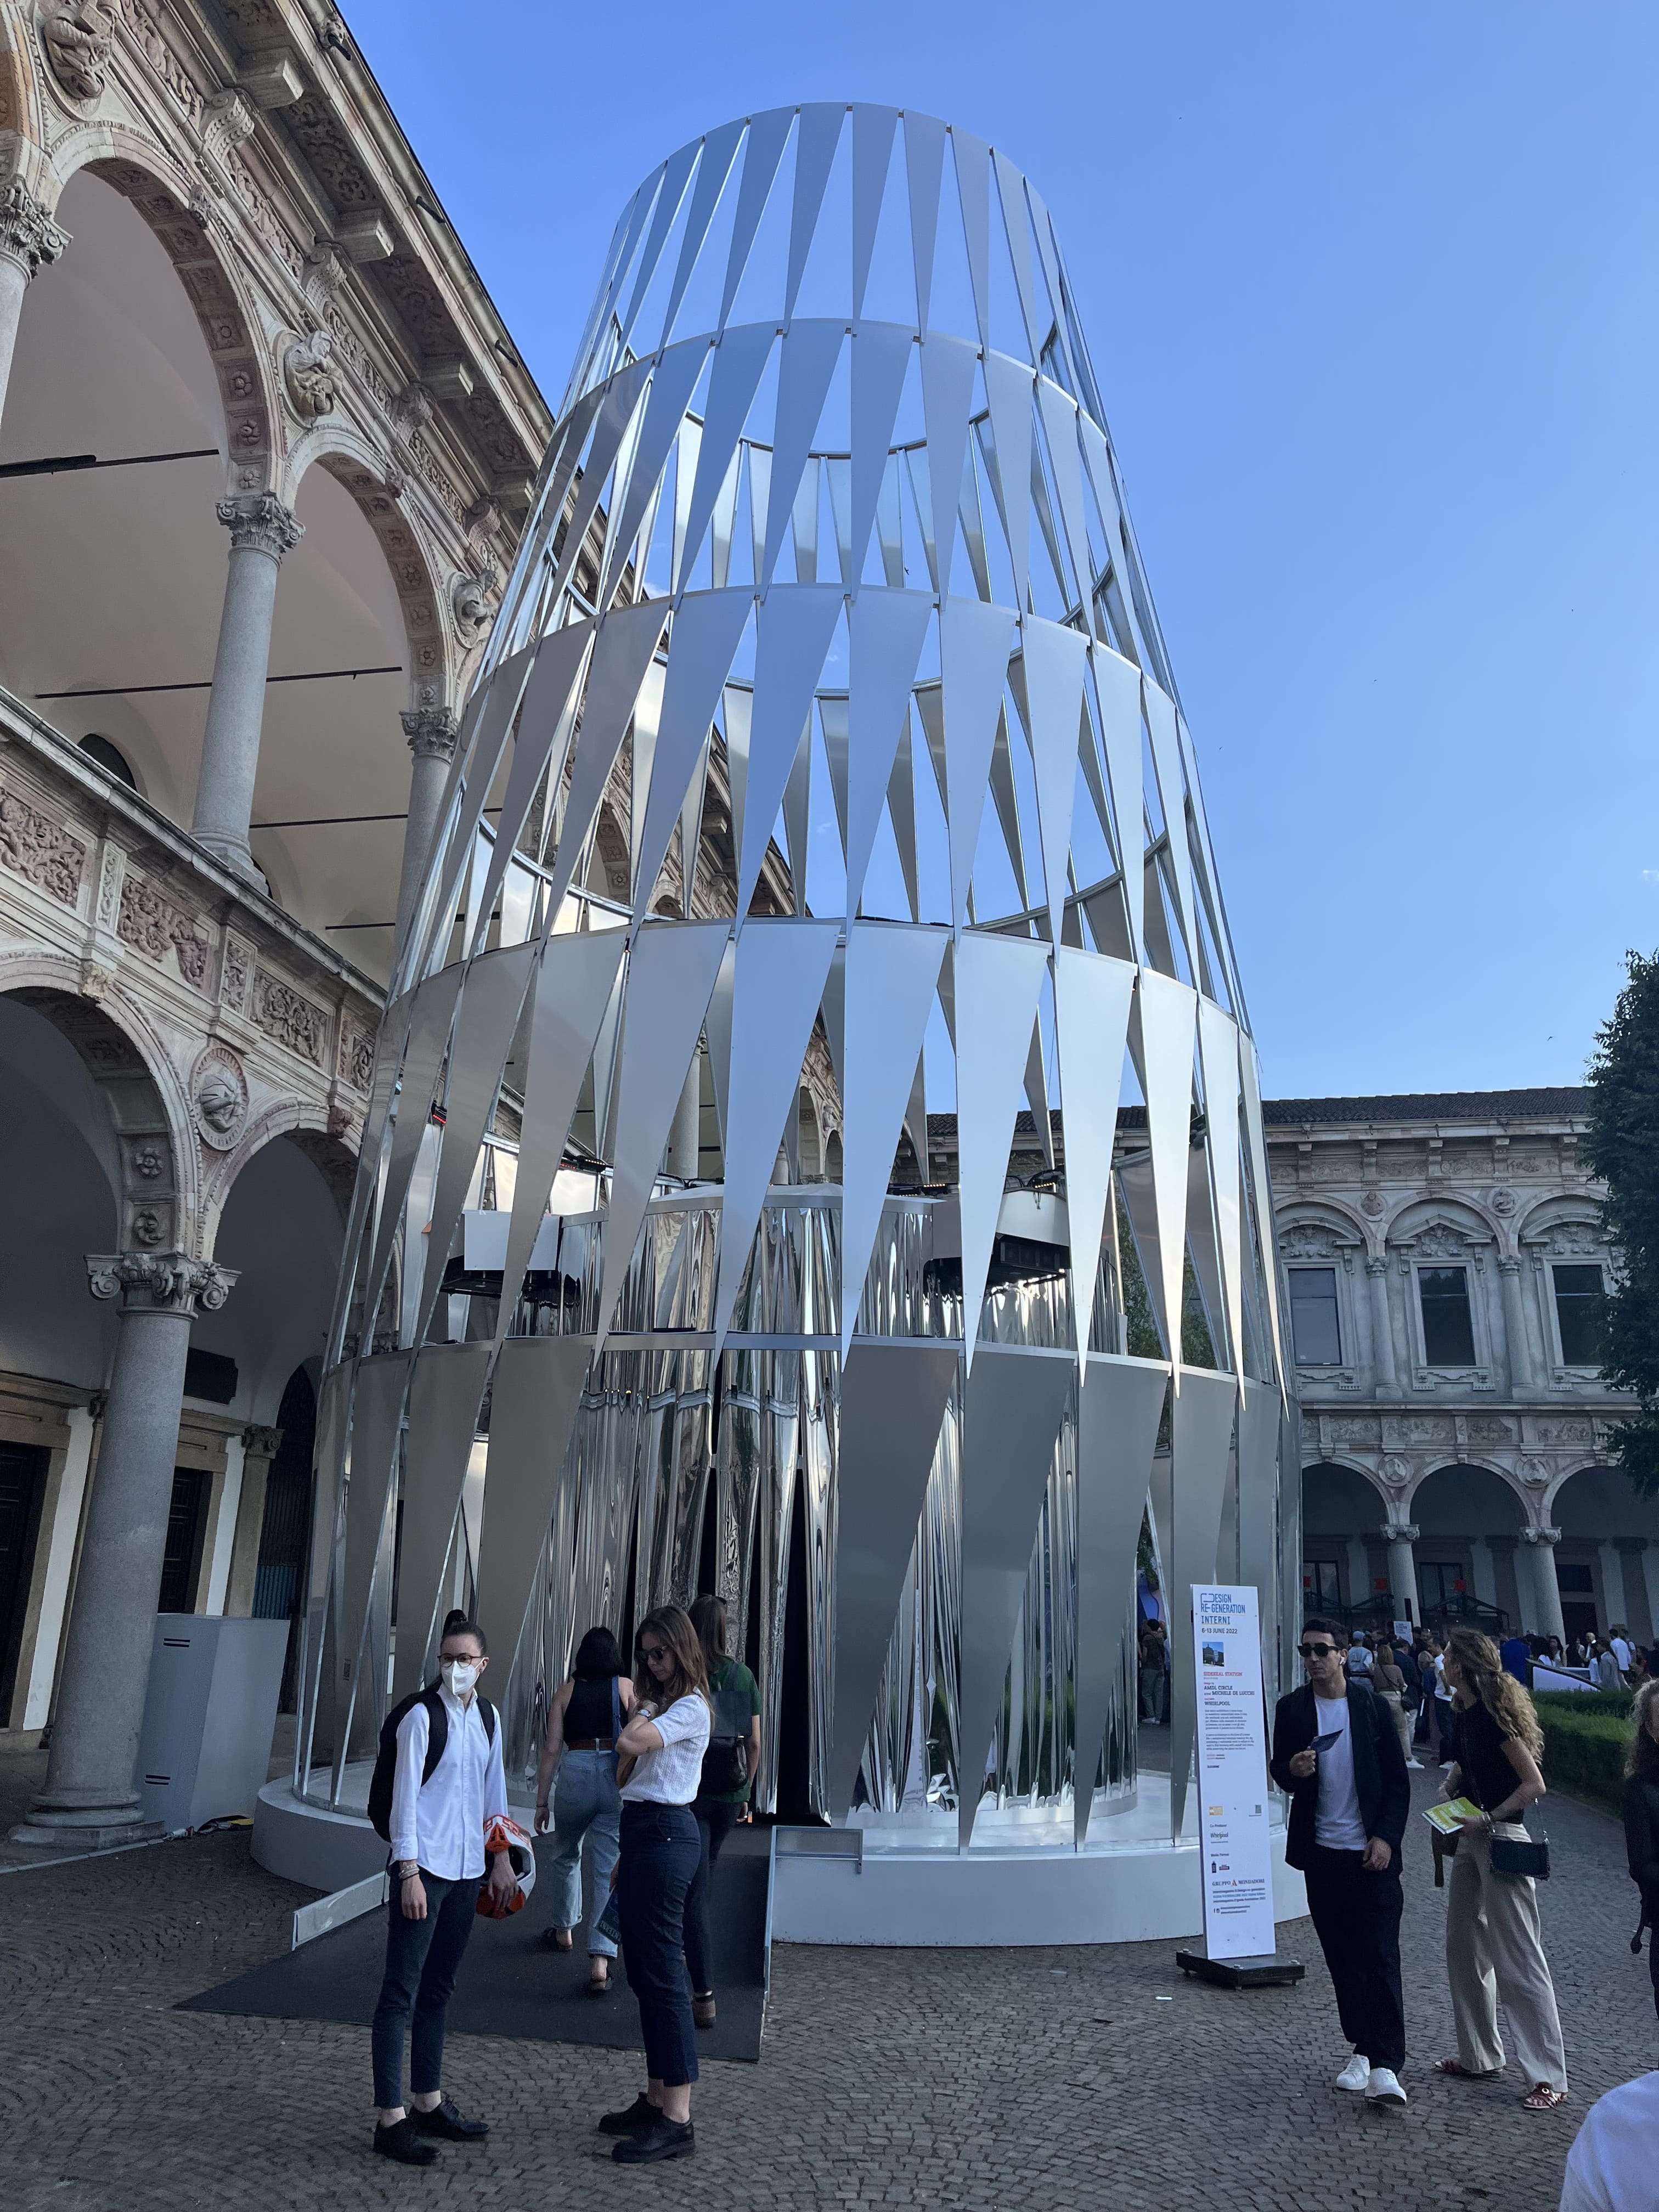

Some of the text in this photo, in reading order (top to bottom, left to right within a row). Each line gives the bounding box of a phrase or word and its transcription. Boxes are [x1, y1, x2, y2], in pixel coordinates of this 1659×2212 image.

[1200, 1593, 1232, 1603] DESIGN
[1201, 1604, 1246, 1613] RE-GENERATION
[1201, 1616, 1231, 1624] INTERNI
